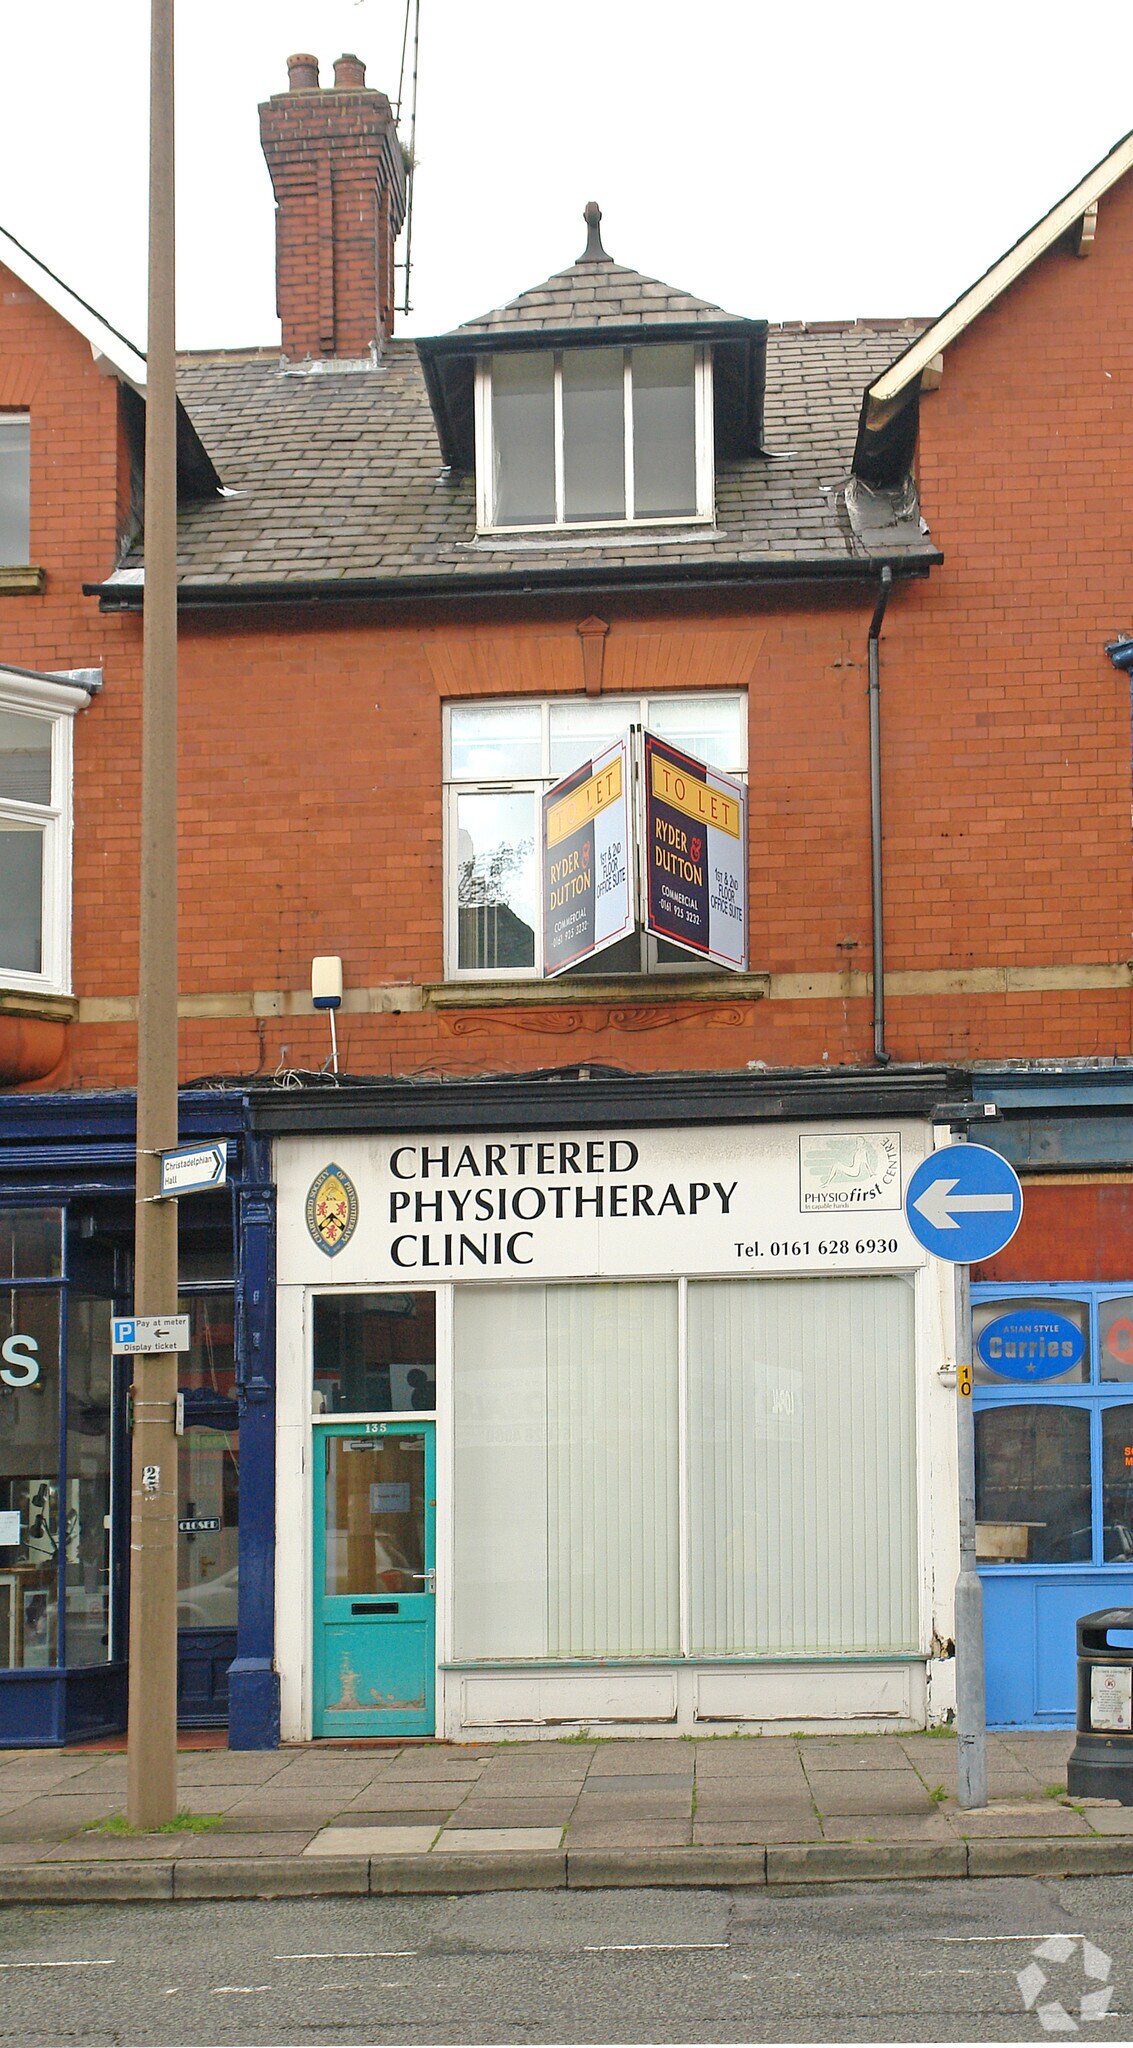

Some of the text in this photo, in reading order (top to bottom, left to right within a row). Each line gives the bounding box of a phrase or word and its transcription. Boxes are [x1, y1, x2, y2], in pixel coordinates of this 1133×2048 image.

[556, 771, 613, 833] TO LET
[663, 769, 730, 825] TO LET
[655, 817, 702, 862] RYDER &
[550, 840, 591, 885] RYDER &
[602, 857, 619, 879] FLOOR
[655, 845, 703, 887] DUTTON
[550, 868, 591, 911] DUTTON
[596, 866, 626, 899] OFFICE SUITE
[718, 883, 736, 904] FLOOR
[661, 884, 699, 911] COMMERCIAL
[710, 894, 743, 922] OFFICE SUITE
[554, 907, 587, 933] COMMERCIAL
[673, 905, 684, 919] 925
[165, 1156, 213, 1172] Christadelphian
[389, 1140, 640, 1180] CHARTERED
[880, 1137, 899, 1185] CENTRE
[165, 1176, 177, 1186] Hall
[310, 1170, 330, 1199] SOCIETY
[336, 1171, 348, 1182] OF
[341, 1181, 358, 1244] PHYSIOTHERAPY
[389, 1181, 738, 1224] PHYSIOTHERAPY
[390, 1231, 534, 1268] CLINIC
[734, 1238, 898, 1257] Tel. 0161 628 6930
[118, 1323, 132, 1342] P
[136, 1320, 150, 1328] Pay
[1003, 1324, 1059, 1333] ASIAN STYLE
[124, 1342, 177, 1352] Display ticket
[989, 1336, 1073, 1359] Curries
[366, 1423, 387, 1433] 135
[180, 1520, 217, 1530] CLOSED
